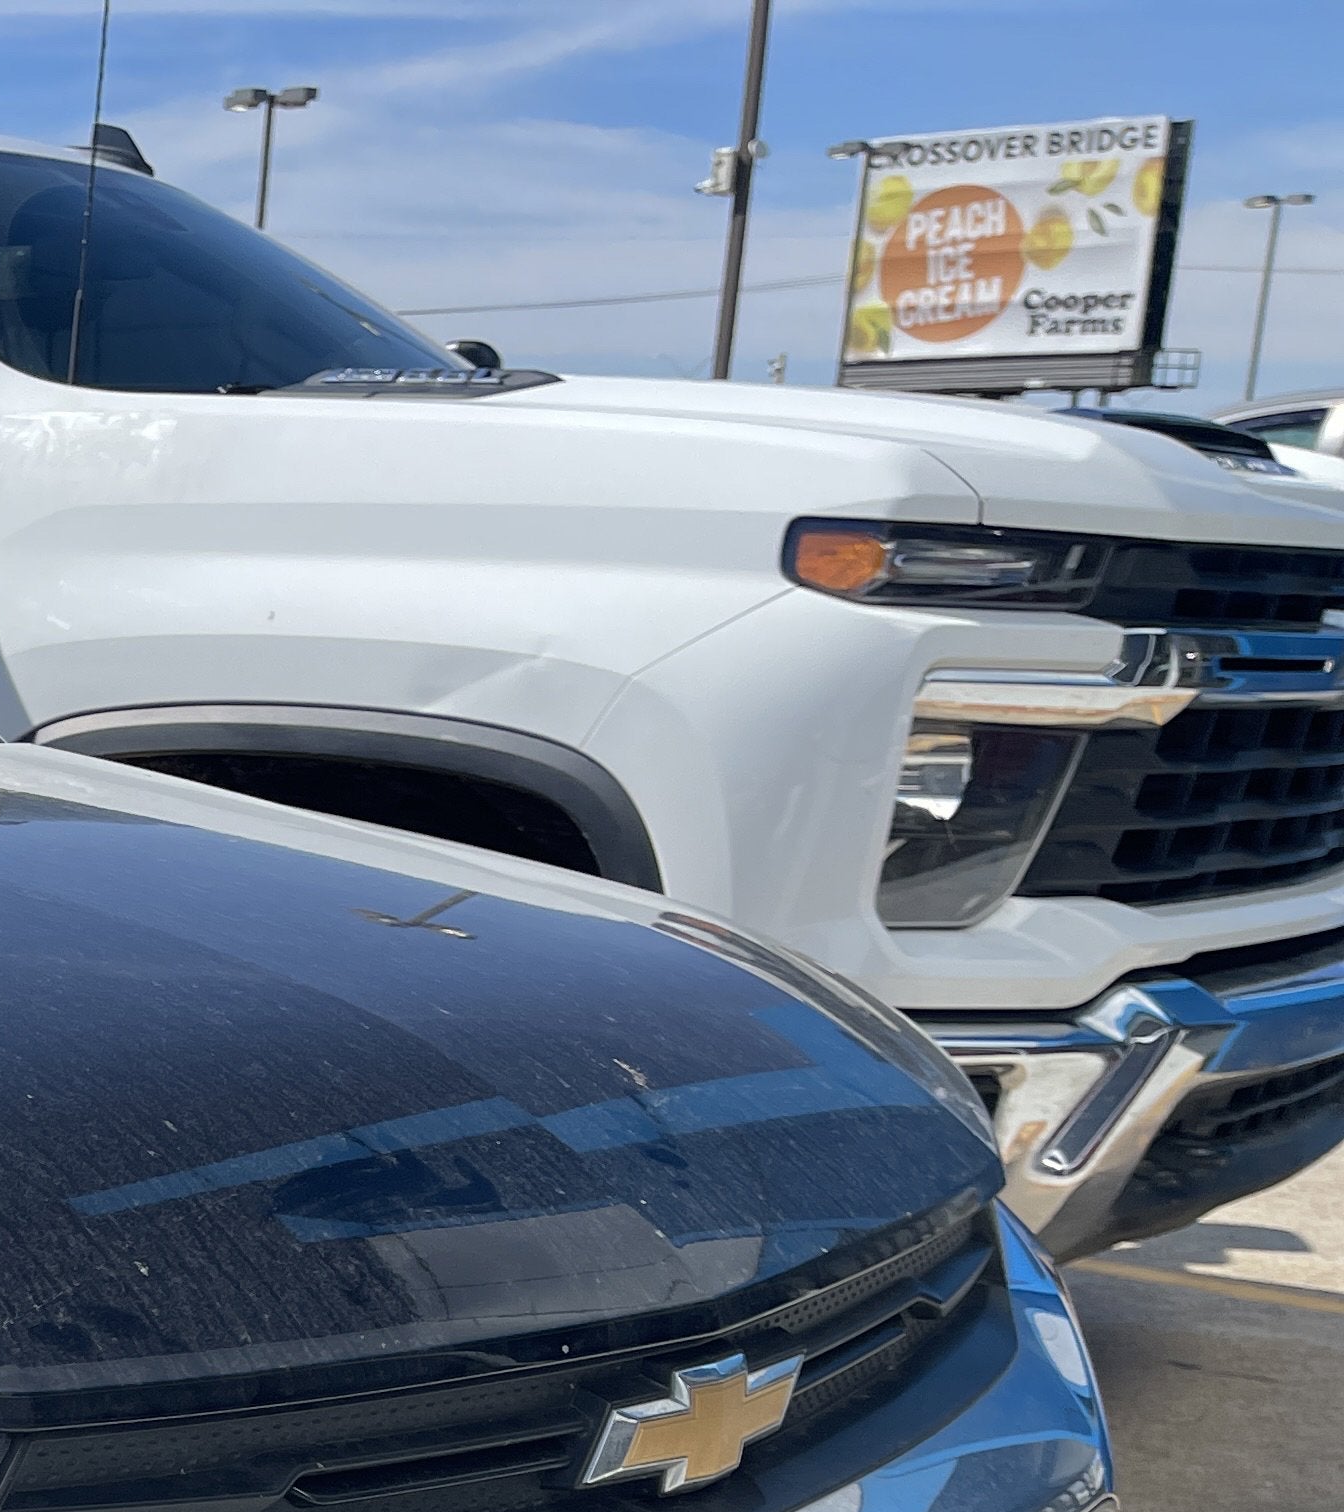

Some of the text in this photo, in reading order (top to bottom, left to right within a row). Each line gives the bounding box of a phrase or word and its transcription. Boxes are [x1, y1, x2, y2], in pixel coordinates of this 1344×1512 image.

[1046, 124, 1160, 157] BRIDGE
[905, 198, 1008, 251] PEACH
[926, 241, 977, 286] ICE
[896, 275, 1004, 329] CREAM
[1023, 288, 1136, 314] Cooper
[1027, 314, 1126, 337] Farms
